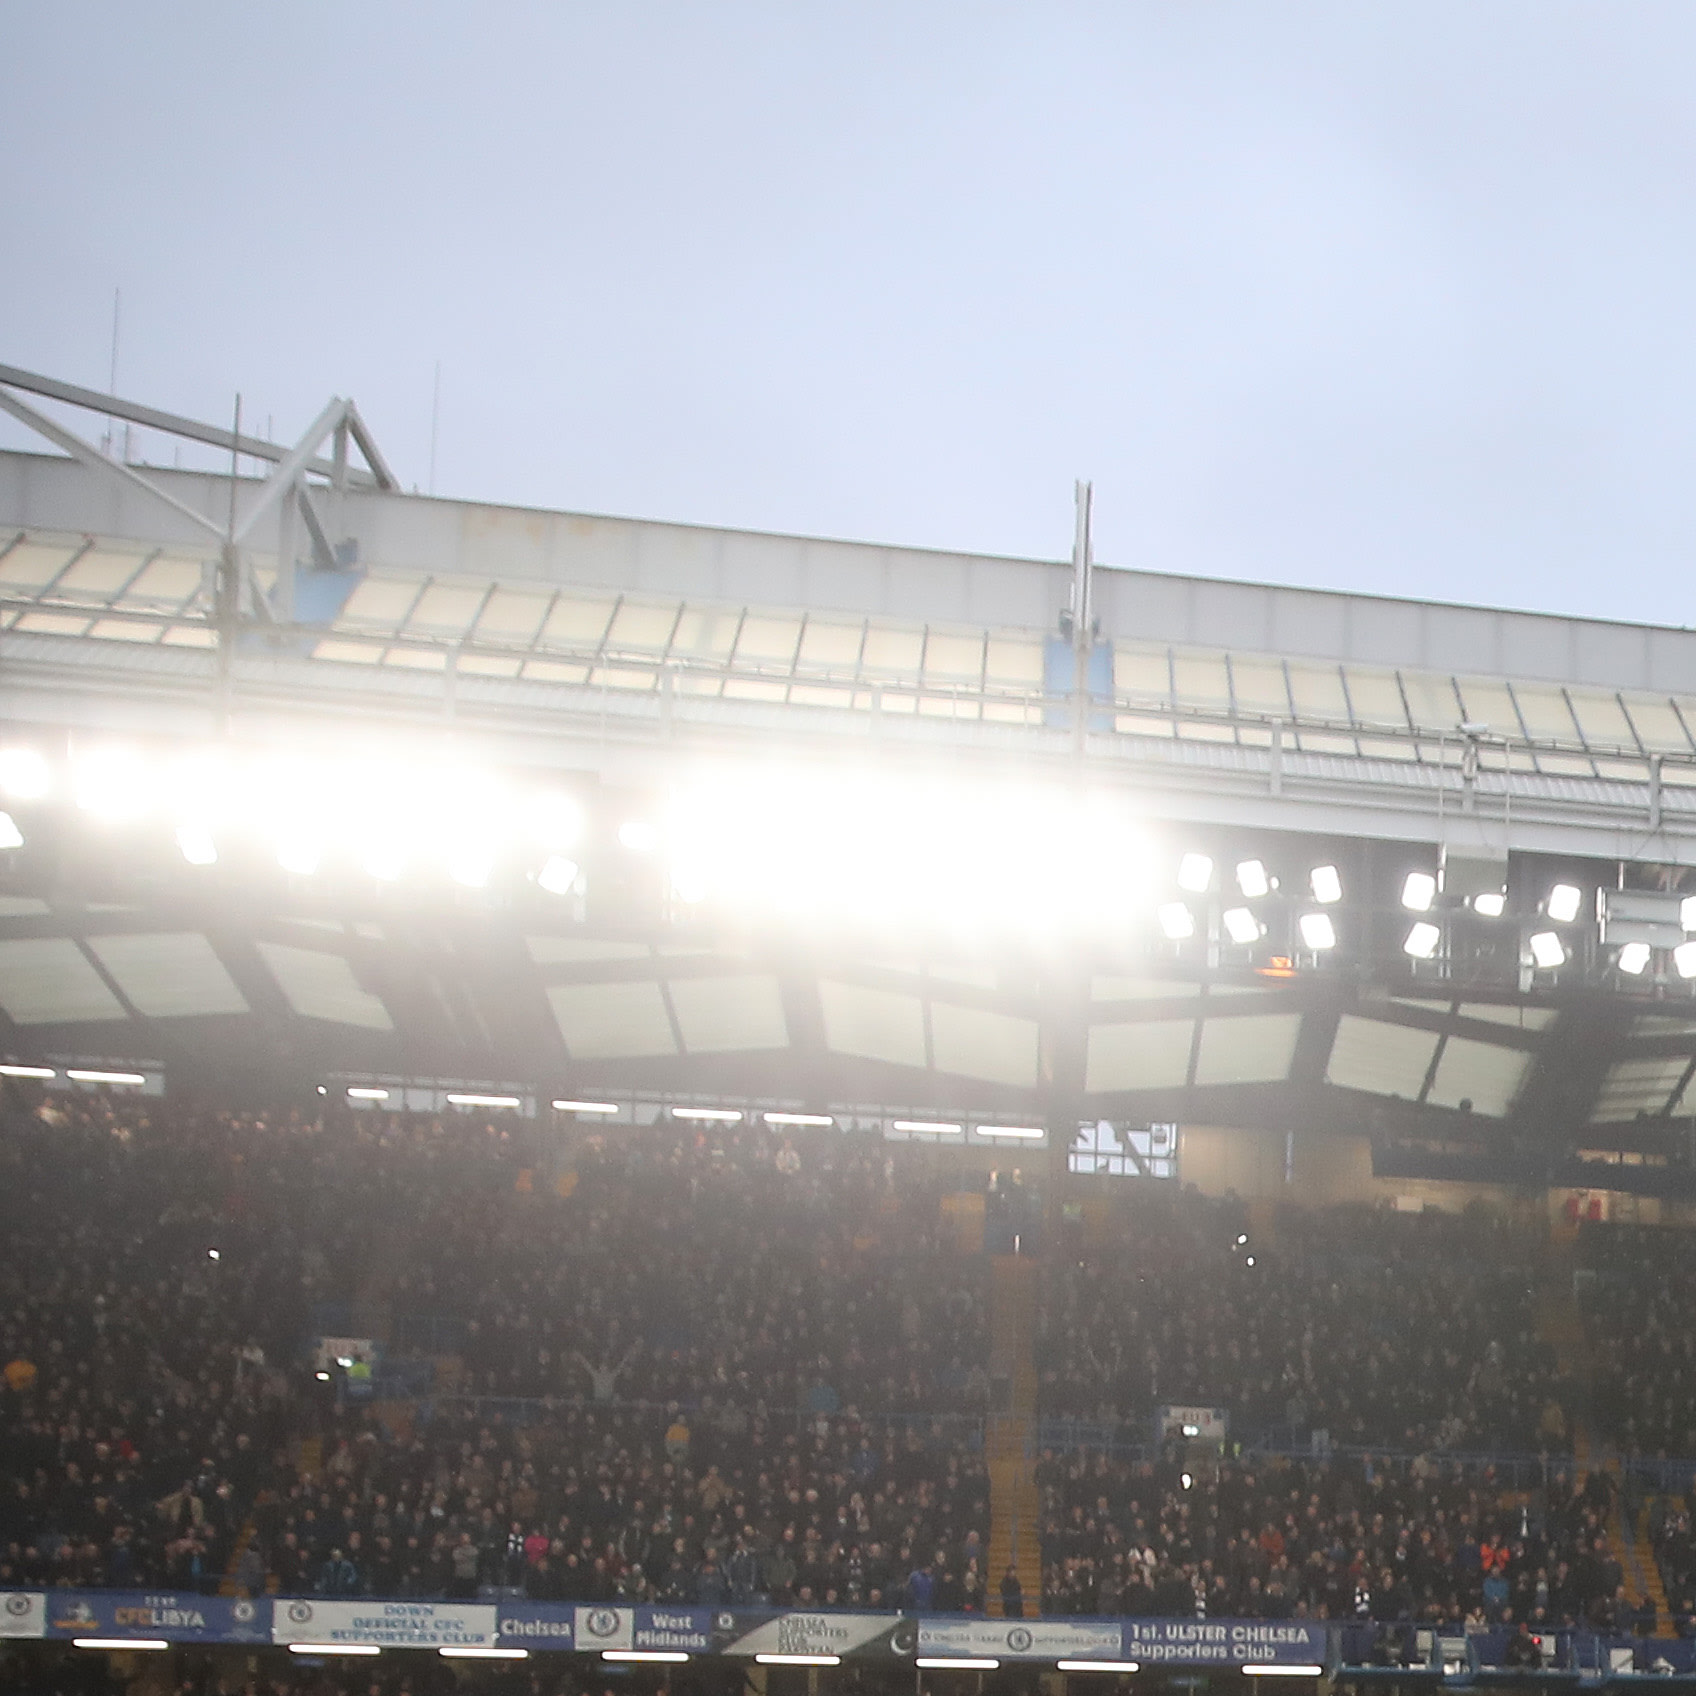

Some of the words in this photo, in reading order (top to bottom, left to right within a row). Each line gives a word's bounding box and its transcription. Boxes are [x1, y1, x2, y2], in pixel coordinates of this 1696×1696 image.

[384, 1604, 434, 1616] DOWN
[353, 1616, 426, 1630] OFFICIAL
[434, 1619, 465, 1631] CFC
[502, 1618, 571, 1638] Chelsea
[653, 1612, 692, 1630] West
[331, 1629, 437, 1643] SUPPORTERS
[443, 1631, 485, 1643] CLUB
[636, 1630, 706, 1648] Midlands
[1167, 1625, 1226, 1642] ULSTER
[1232, 1627, 1310, 1644] CHELSEA
[1131, 1641, 1227, 1661] Supporters
[1233, 1644, 1276, 1659] Club
